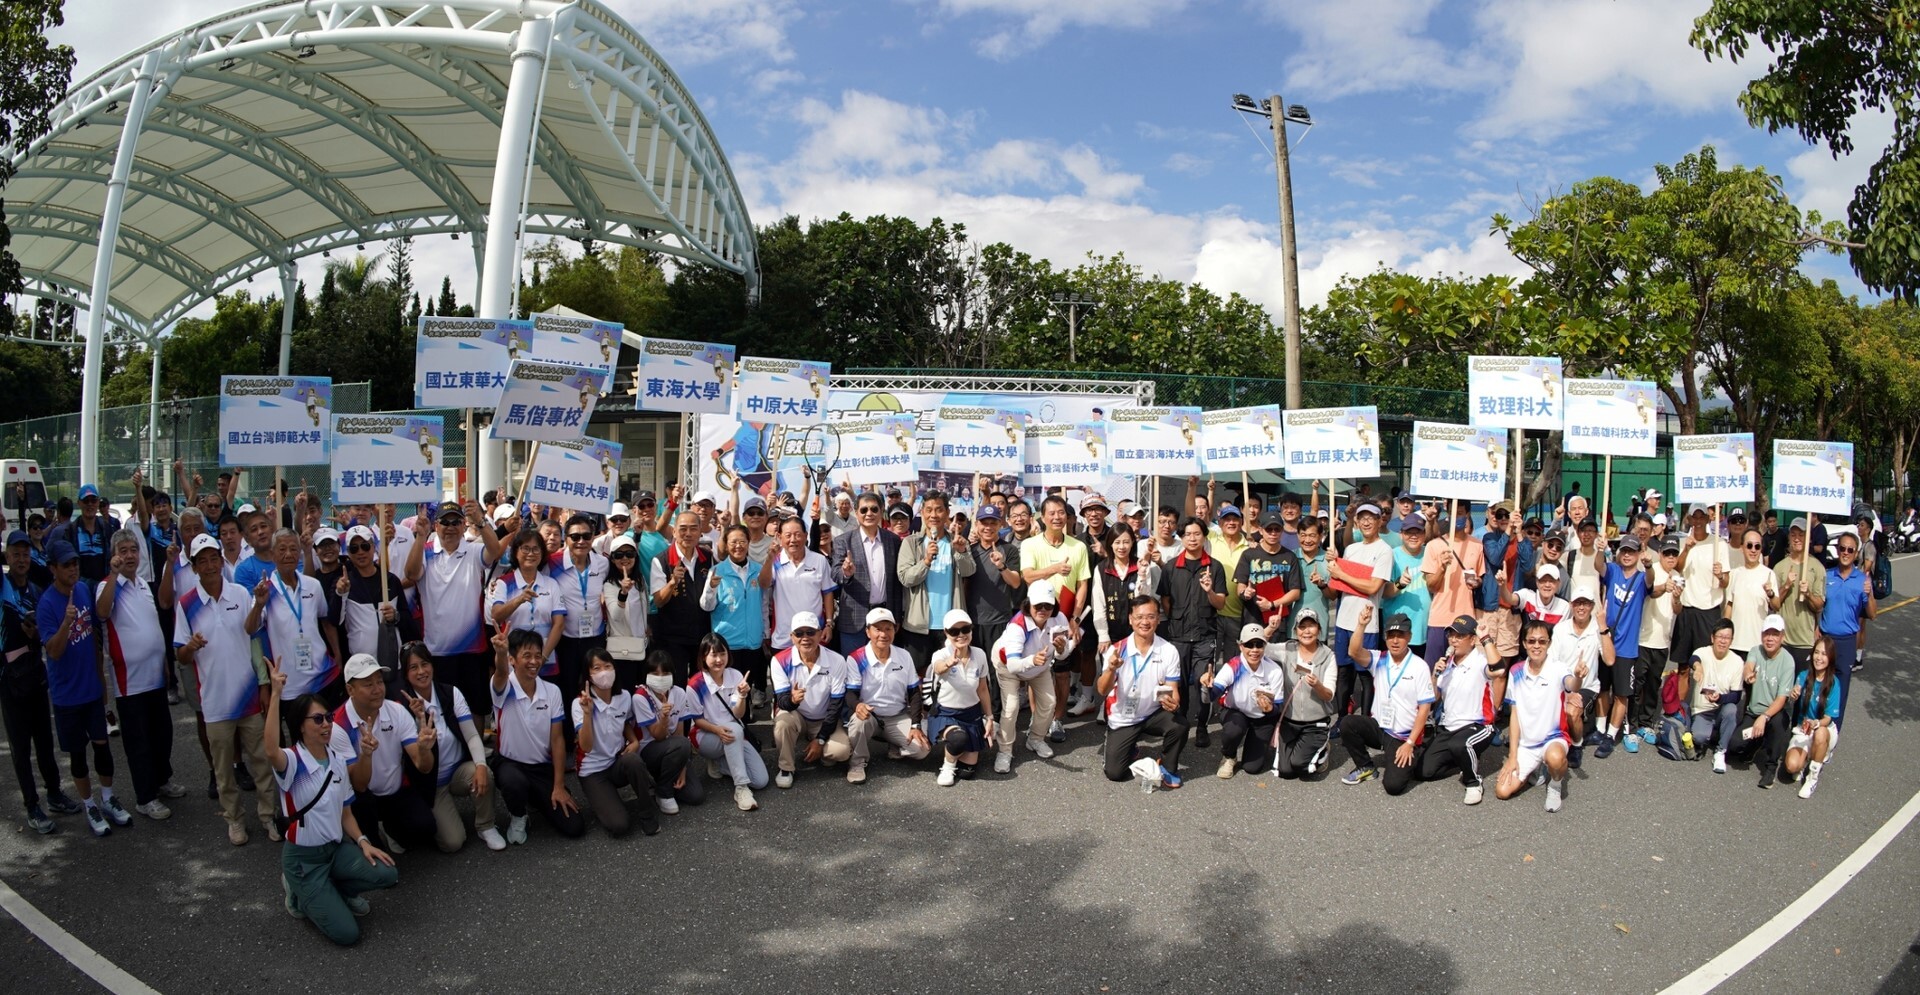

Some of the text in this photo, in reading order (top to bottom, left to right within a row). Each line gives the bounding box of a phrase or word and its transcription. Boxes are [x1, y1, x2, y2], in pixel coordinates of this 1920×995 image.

[646, 377, 721, 401] 東海大學
[746, 395, 818, 417] 中原大學
[1479, 396, 1553, 417] 致理科大
[504, 403, 582, 427] 馬偕專校
[229, 430, 321, 445] 國立台灣師範大學
[1571, 425, 1649, 440] 國立高雄科技大學
[942, 444, 1018, 458] 國立中央大學
[1115, 448, 1195, 461] 國立臺灣海洋大學
[1206, 444, 1275, 461] 國立臺中科大
[1292, 447, 1373, 465] 國立屏東大學
[833, 453, 910, 469] 國立彰化師範大學
[1024, 461, 1100, 474] 國立臺灣藝術大學
[342, 469, 435, 488] 臺北醫學大學
[1420, 468, 1498, 483] 國立臺北科技大學
[1682, 475, 1749, 490] 國立臺灣大學
[534, 476, 609, 500] 國立中興大學
[1779, 483, 1846, 500] 國立臺北教育大學
[1250, 558, 1291, 573] Kappa
